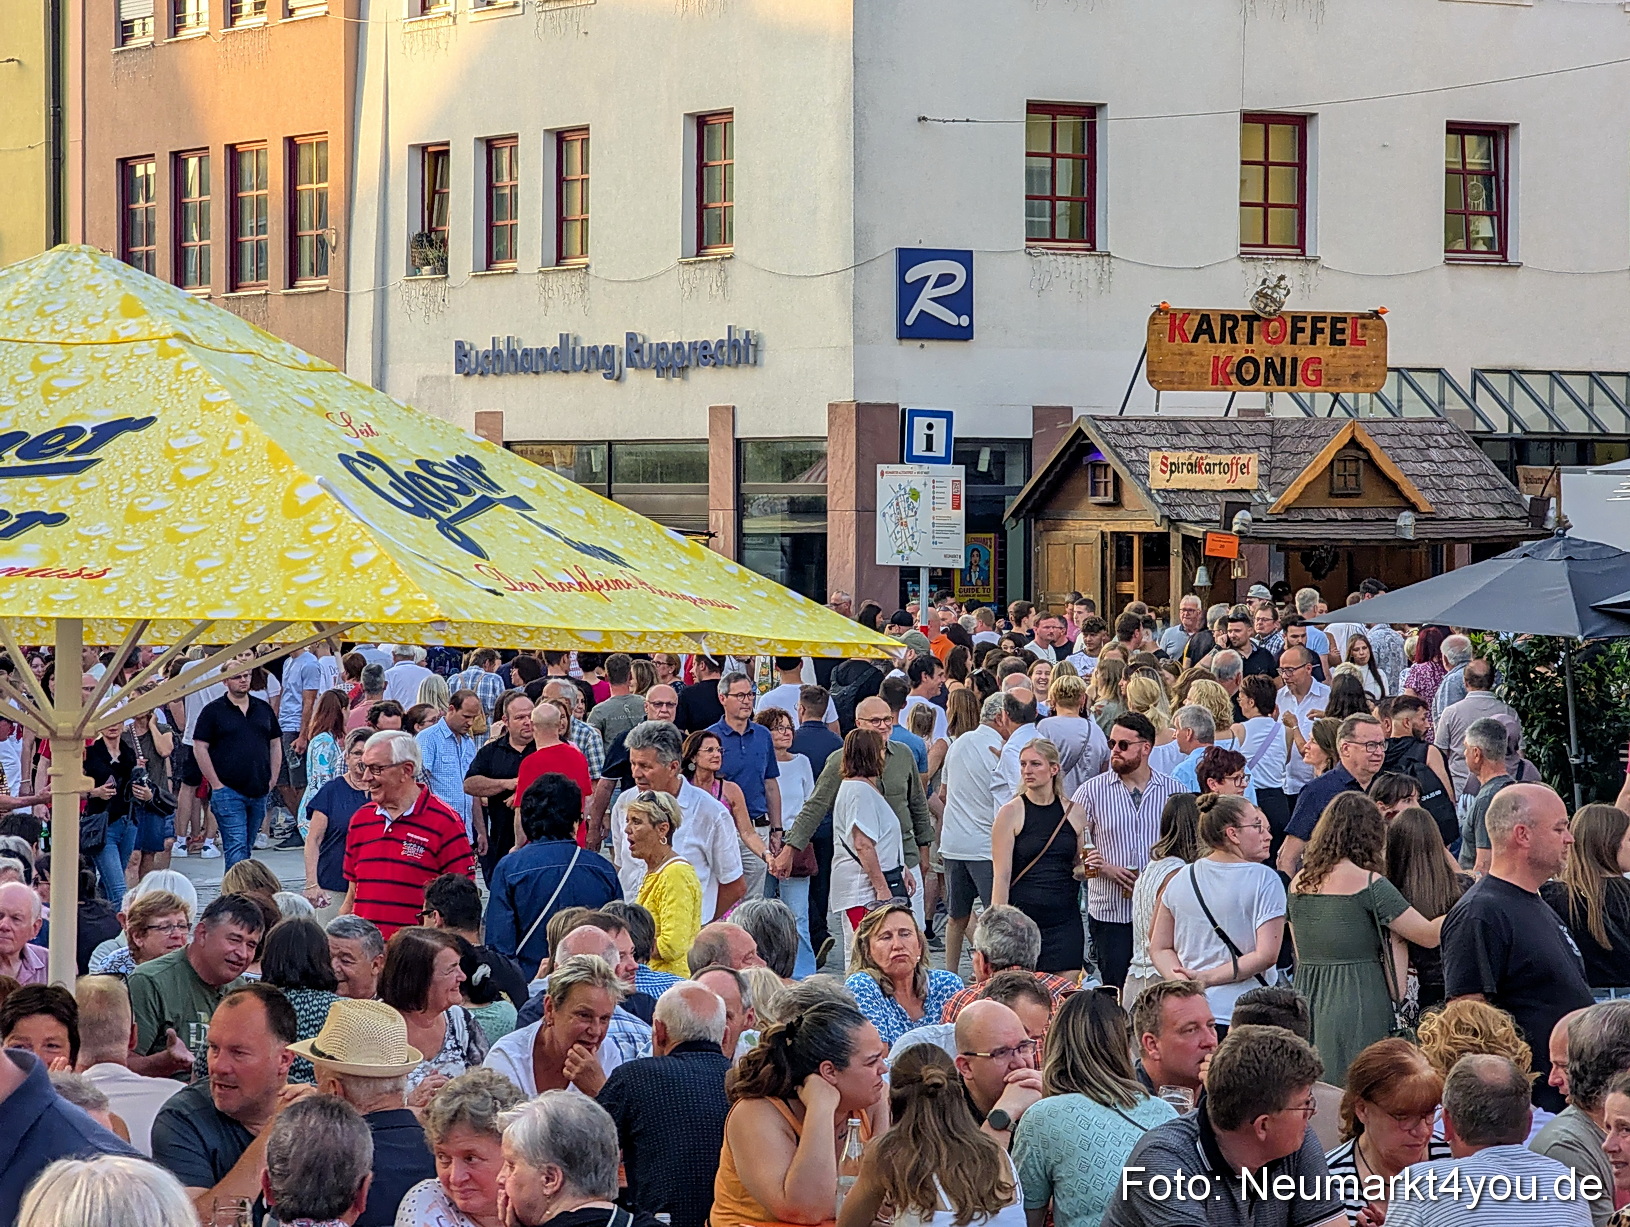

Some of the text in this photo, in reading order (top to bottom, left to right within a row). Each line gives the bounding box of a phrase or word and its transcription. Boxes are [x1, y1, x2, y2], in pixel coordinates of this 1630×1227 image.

[1167, 312, 1366, 347] KARTOFFEL
[454, 324, 758, 381] Buchhandlung Rupprecht
[1210, 348, 1323, 388] KÖNIG
[325, 412, 379, 439] Seit
[1158, 454, 1251, 483] Spiralkartoffel
